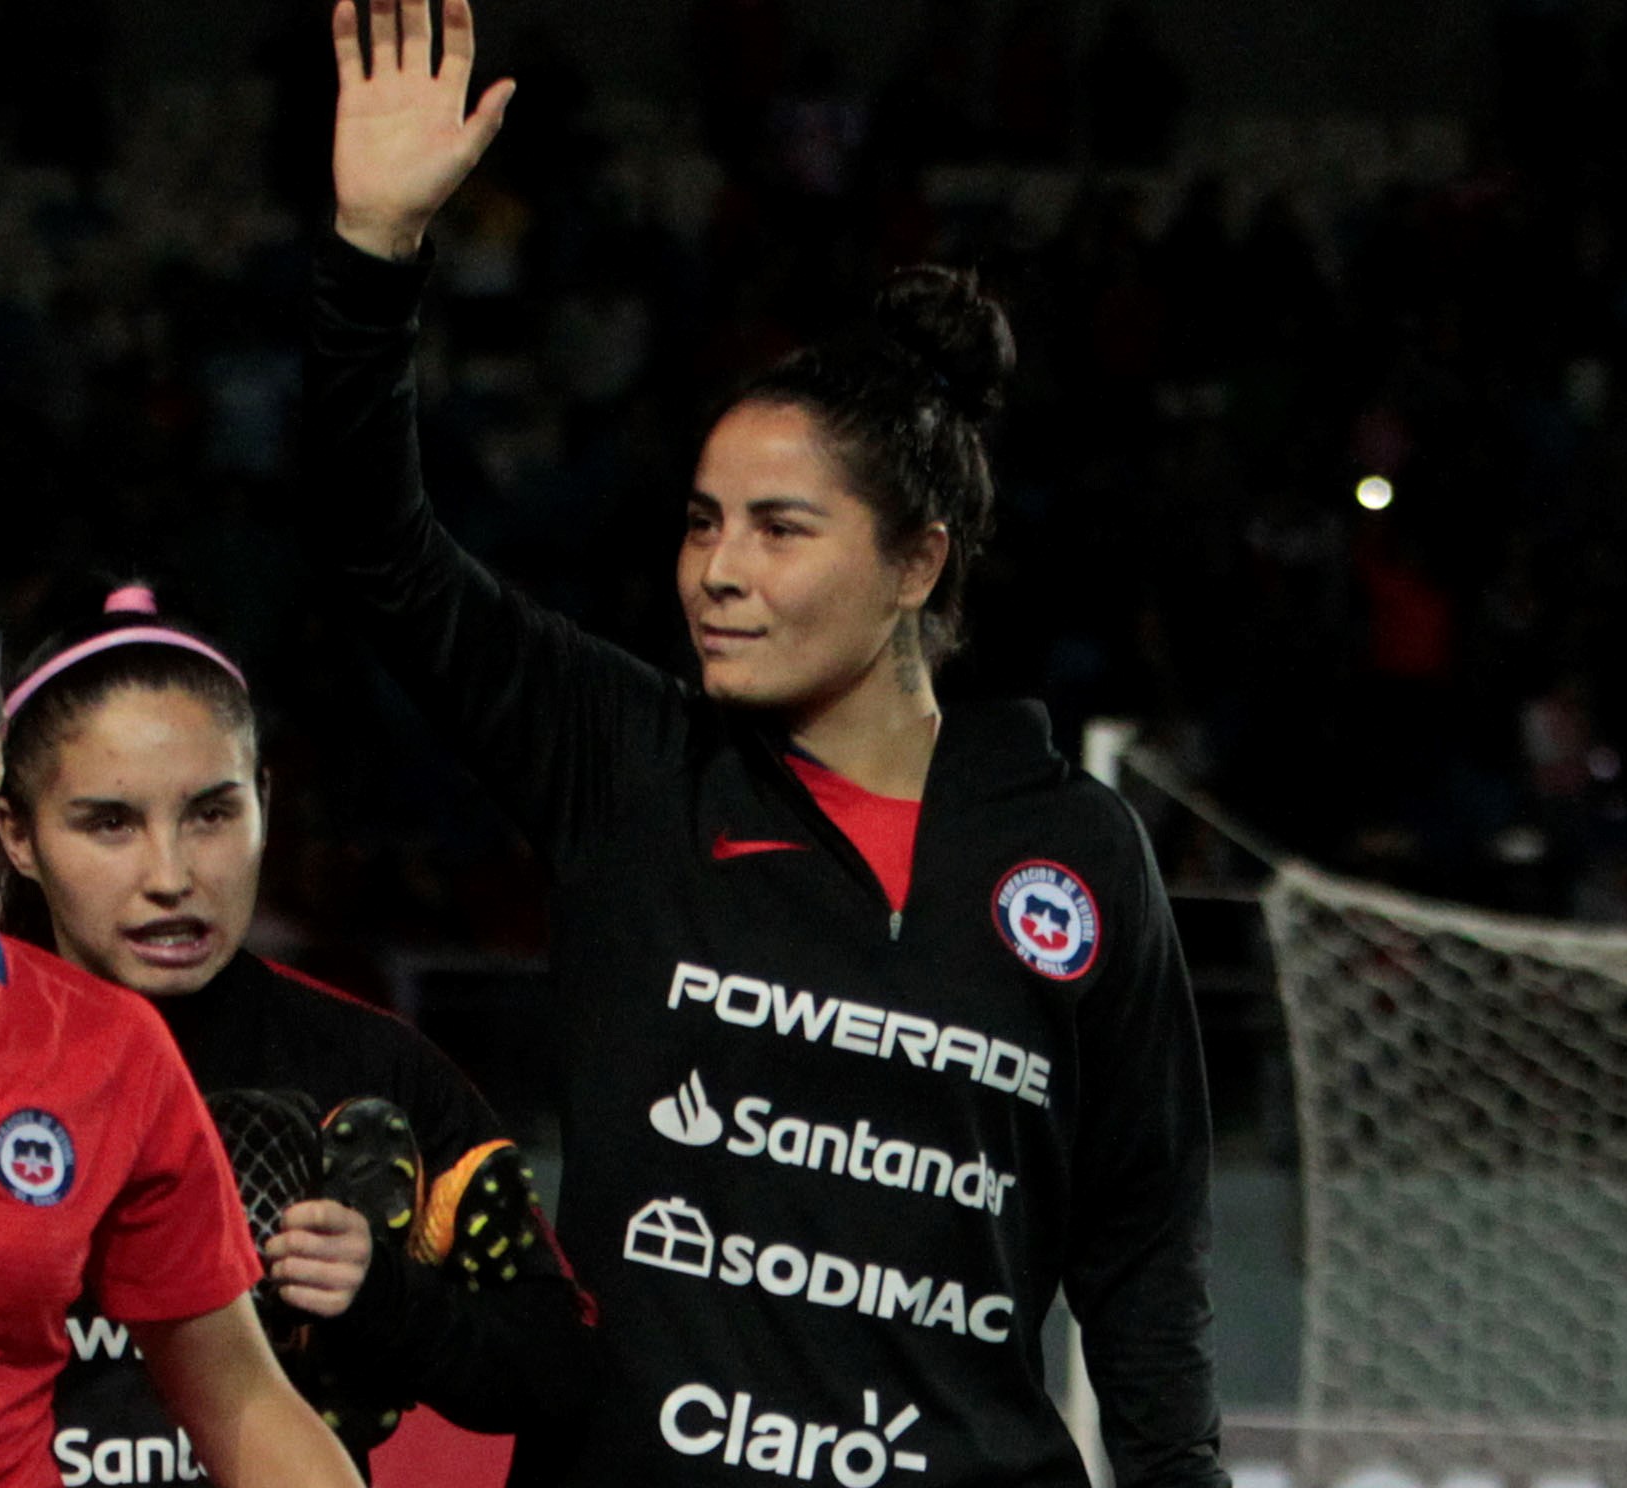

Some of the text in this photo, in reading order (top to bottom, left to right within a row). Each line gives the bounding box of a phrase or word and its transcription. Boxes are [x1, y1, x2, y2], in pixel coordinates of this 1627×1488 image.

[667, 961, 1051, 1107] POWERADE
[726, 1097, 1016, 1217] Santander
[719, 1235, 1014, 1343] SODIMAC
